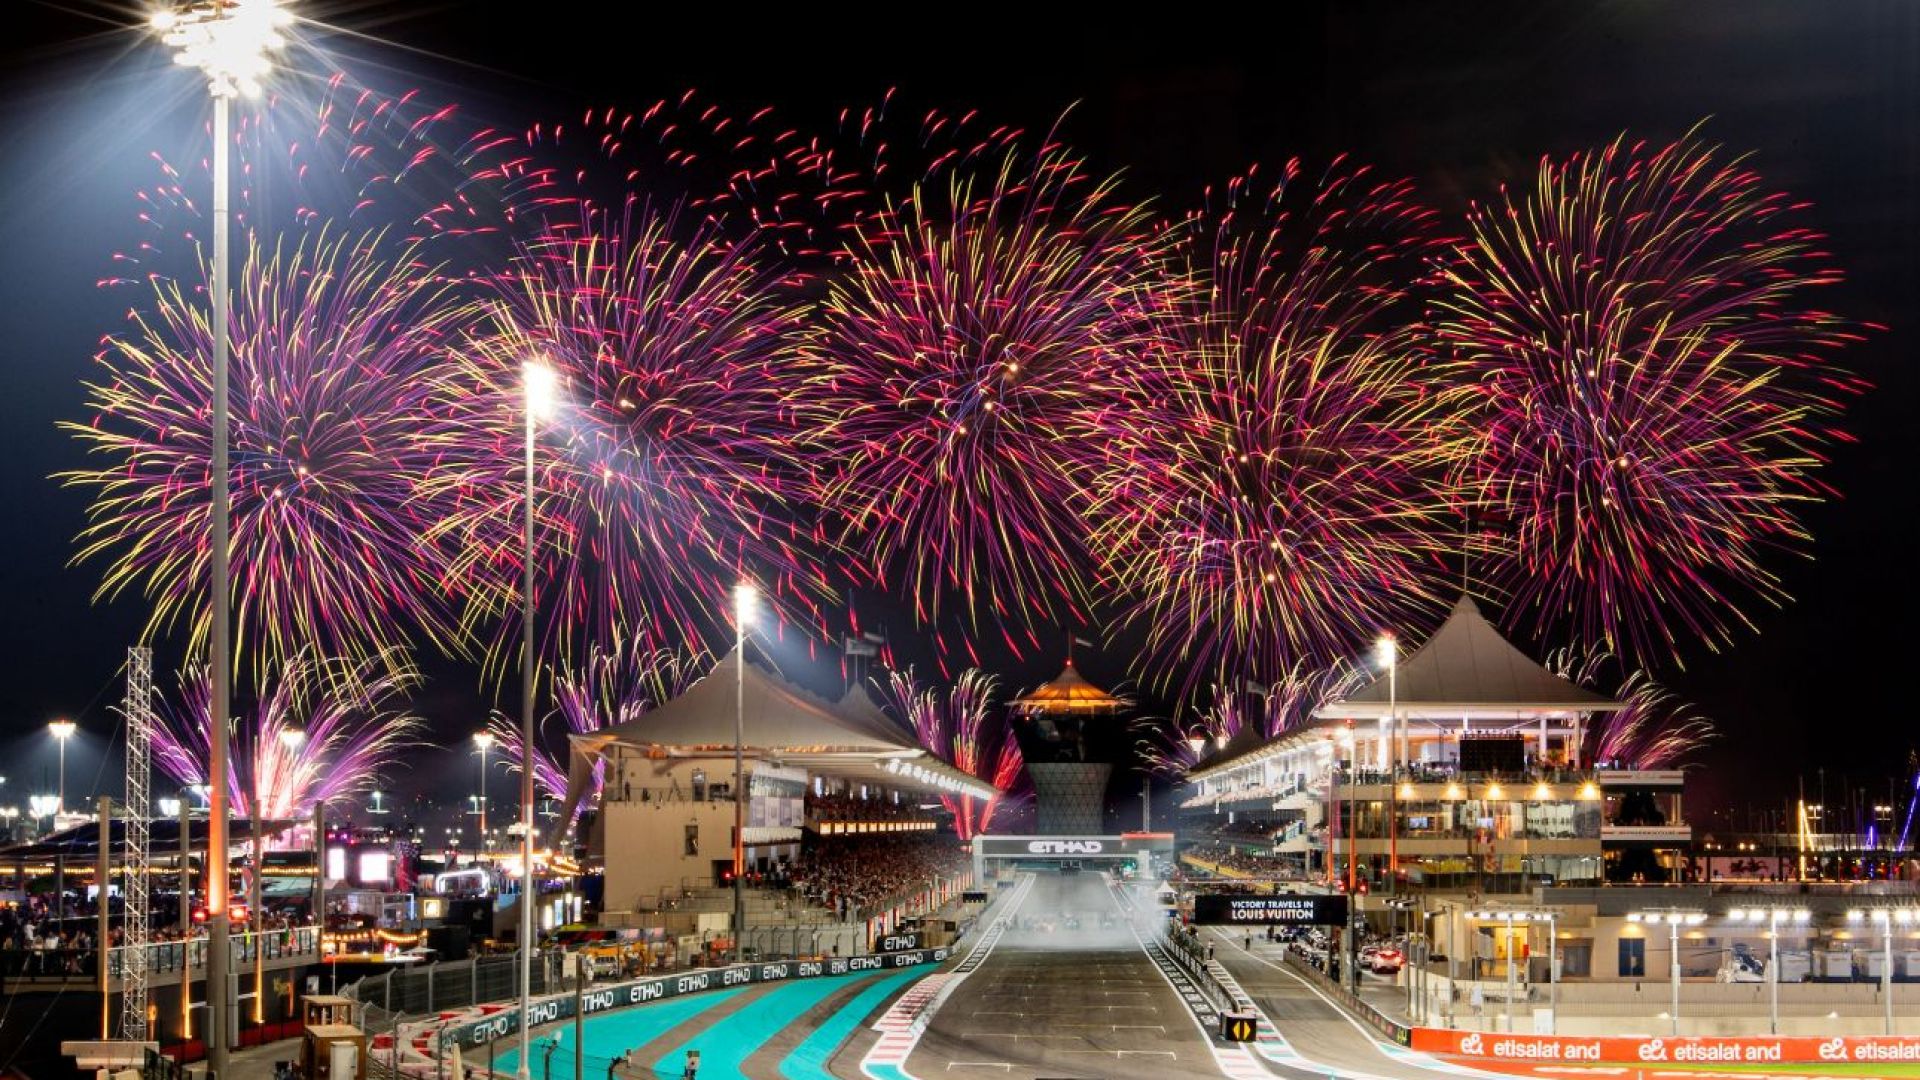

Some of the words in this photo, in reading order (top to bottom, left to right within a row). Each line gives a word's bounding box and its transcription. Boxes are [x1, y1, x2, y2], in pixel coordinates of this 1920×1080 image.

[1028, 840, 1102, 853] ETIHAD
[1231, 900, 1265, 909] VICTORY
[1267, 900, 1302, 909] TRAVELS
[1303, 900, 1314, 909] IN
[1231, 909, 1265, 920] LOUIS
[1267, 909, 1314, 920] VUITTON
[884, 935, 916, 950] ETIHAD
[849, 956, 882, 970] ETIHAD
[896, 952, 923, 967] ETIHAD
[724, 967, 750, 985] ETIHAD
[763, 964, 788, 979] ETIHAD
[678, 974, 709, 993] ETIHAD
[630, 982, 663, 1002] ETIHAD
[581, 991, 614, 1012] TIHAD
[1461, 1033, 1484, 1055] e&
[1493, 1039, 1560, 1058] etisalat
[1564, 1041, 1601, 1060] and
[1638, 1039, 1668, 1061] e&
[1674, 1042, 1741, 1061] etisalat
[1745, 1042, 1781, 1061] and
[1818, 1037, 1848, 1060] e&
